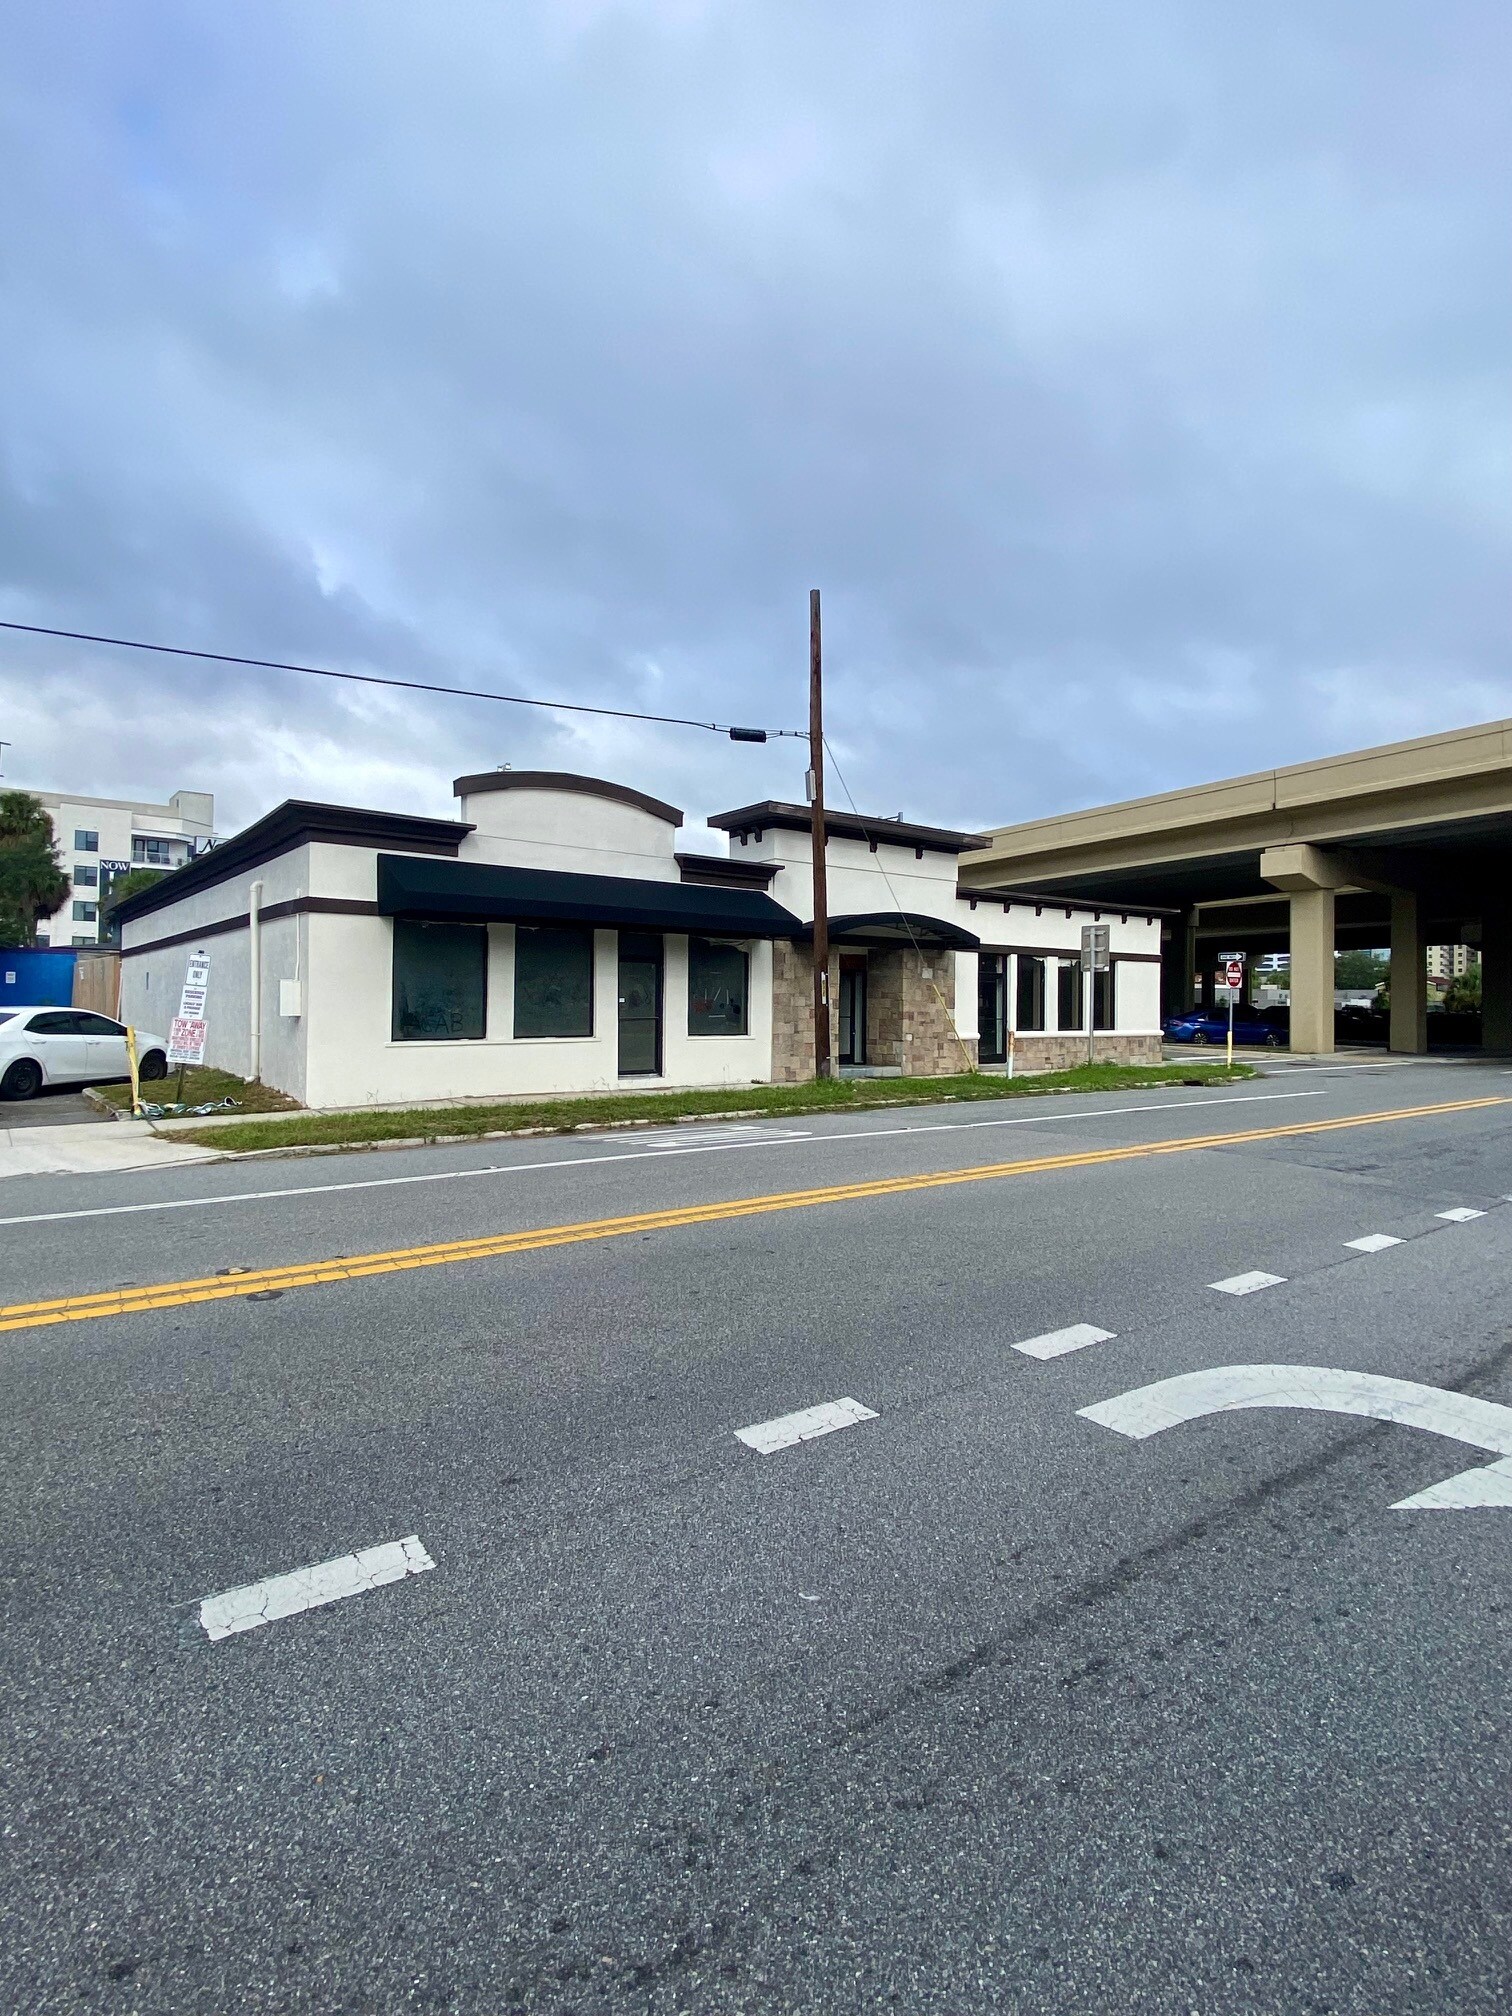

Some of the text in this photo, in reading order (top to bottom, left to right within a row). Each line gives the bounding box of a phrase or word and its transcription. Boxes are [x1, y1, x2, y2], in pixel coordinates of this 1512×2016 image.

[100, 861, 129, 871] NOW
[189, 960, 209, 969] ENTRANCE
[174, 1019, 207, 1030] TOW AWAY
[180, 1029, 197, 1037] ZONE
